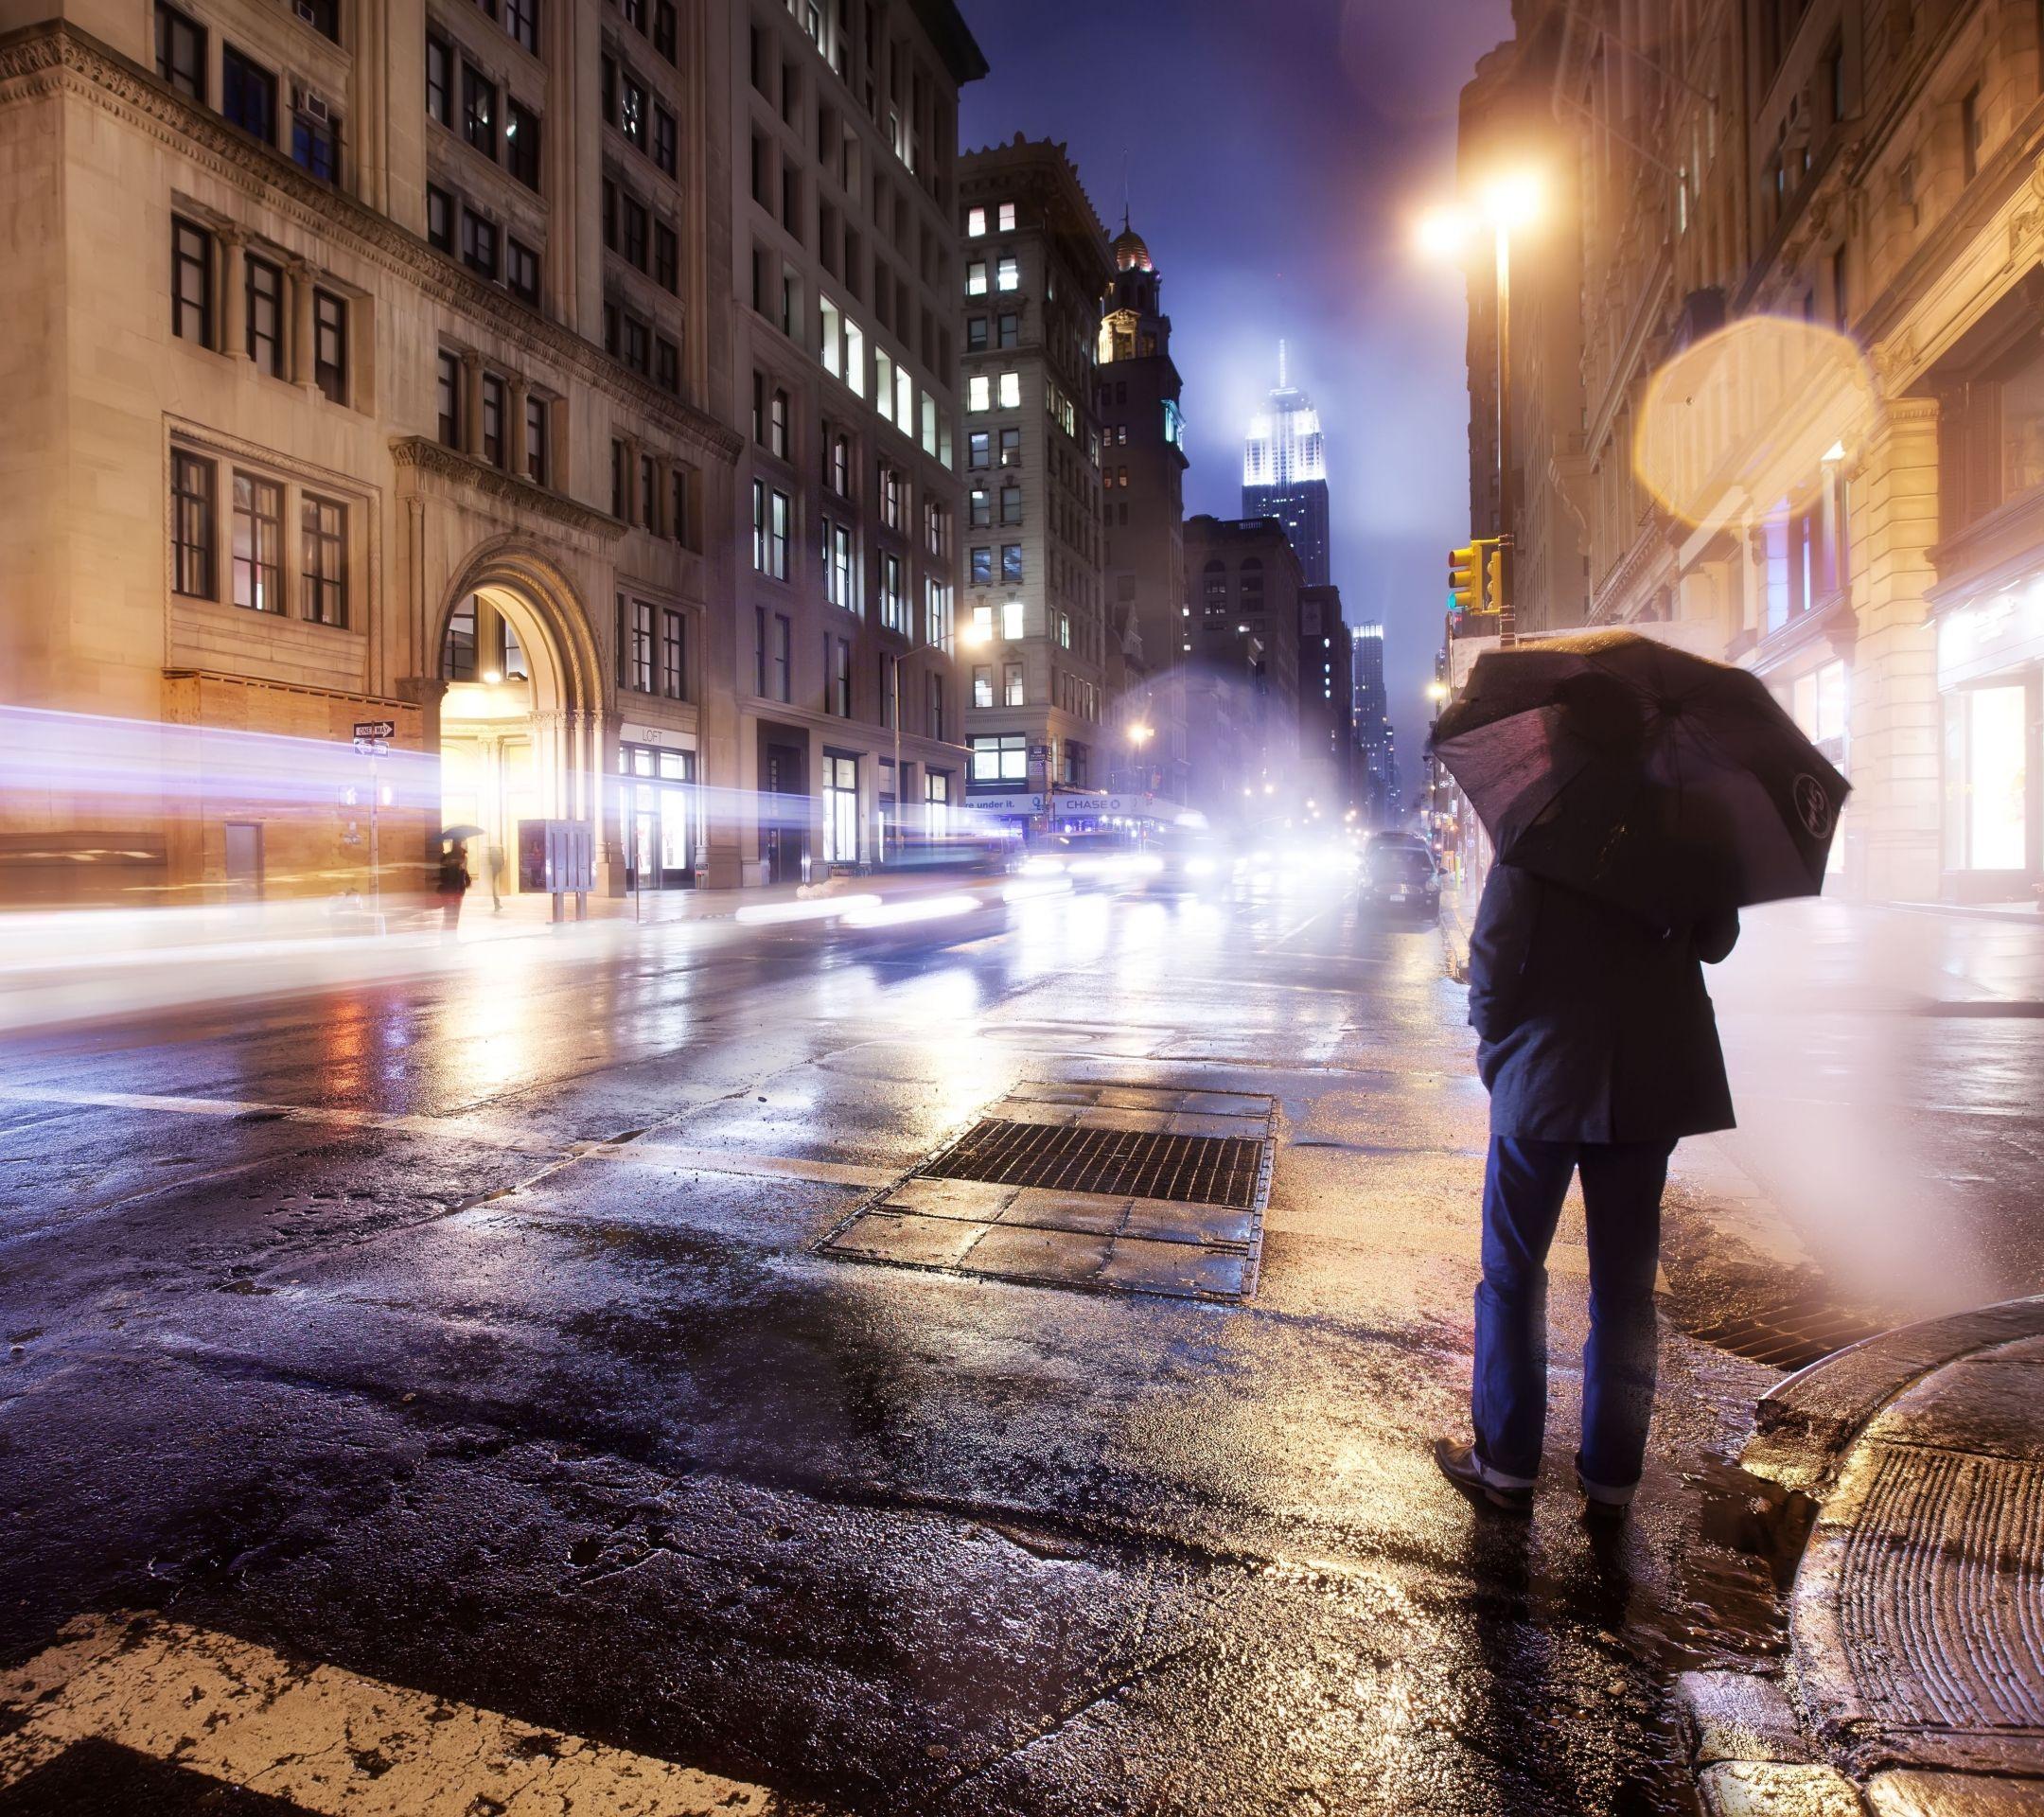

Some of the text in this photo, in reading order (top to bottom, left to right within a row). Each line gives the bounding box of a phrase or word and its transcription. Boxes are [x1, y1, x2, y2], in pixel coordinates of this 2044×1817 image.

[359, 725, 389, 735] ONE WAY
[642, 728, 662, 743] LOFT
[977, 800, 1004, 809] under
[1066, 800, 1108, 809] CHASE
